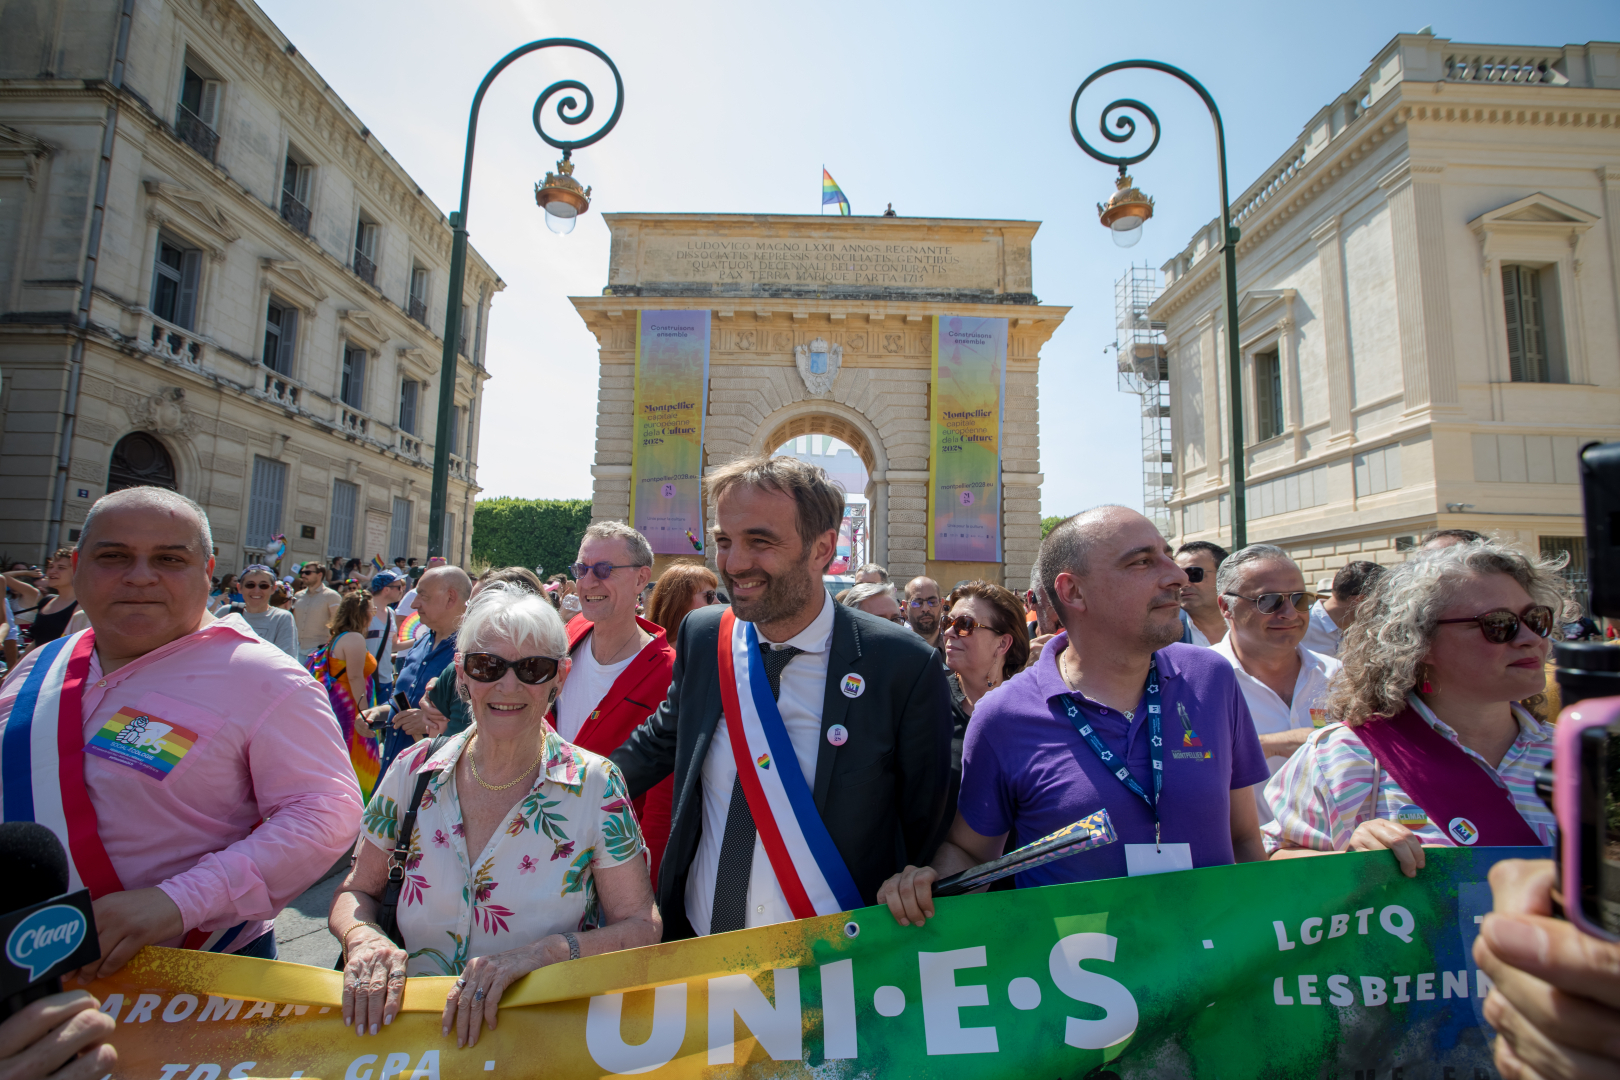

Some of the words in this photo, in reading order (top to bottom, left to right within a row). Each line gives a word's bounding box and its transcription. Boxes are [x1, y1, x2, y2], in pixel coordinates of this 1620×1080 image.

[687, 242, 750, 250] LUDOVICO
[755, 242, 800, 252] MAGNO
[805, 243, 835, 252] LXXII
[841, 244, 880, 253] ANNOS
[886, 245, 952, 255] REGNANTE
[676, 250, 748, 260] DISSOCIATIS
[754, 252, 810, 260] REPRESSIS
[897, 255, 960, 264] GENTIBUS
[692, 260, 753, 271] QUATUOR
[759, 262, 827, 271] DECENNALI
[831, 262, 868, 272] BELLO
[874, 264, 947, 274] CONJURATIS
[719, 270, 744, 280] PAX
[750, 271, 791, 280] TERRA
[795, 272, 850, 282] MARIQUE
[855, 272, 898, 282] PARTA
[903, 274, 924, 283] 1715
[948, 330, 992, 339] Construisons
[644, 402, 695, 412] Montpellier
[647, 412, 678, 421] capitale
[942, 409, 992, 420] Montpellier
[643, 420, 690, 429] européenne
[946, 420, 976, 428] capitale
[662, 426, 696, 436] Culture
[942, 427, 988, 436] européenne
[960, 434, 993, 442] Culture
[642, 474, 697, 484] montpellier2028.eu
[940, 482, 994, 490] montpellier2028.eu
[848, 682, 857, 690] M
[134, 735, 167, 754] PS
[1457, 826, 1470, 837] M
[1272, 904, 1415, 951] LGBTQ
[16, 920, 80, 958] Claap
[344, 1050, 440, 1080] GPA
